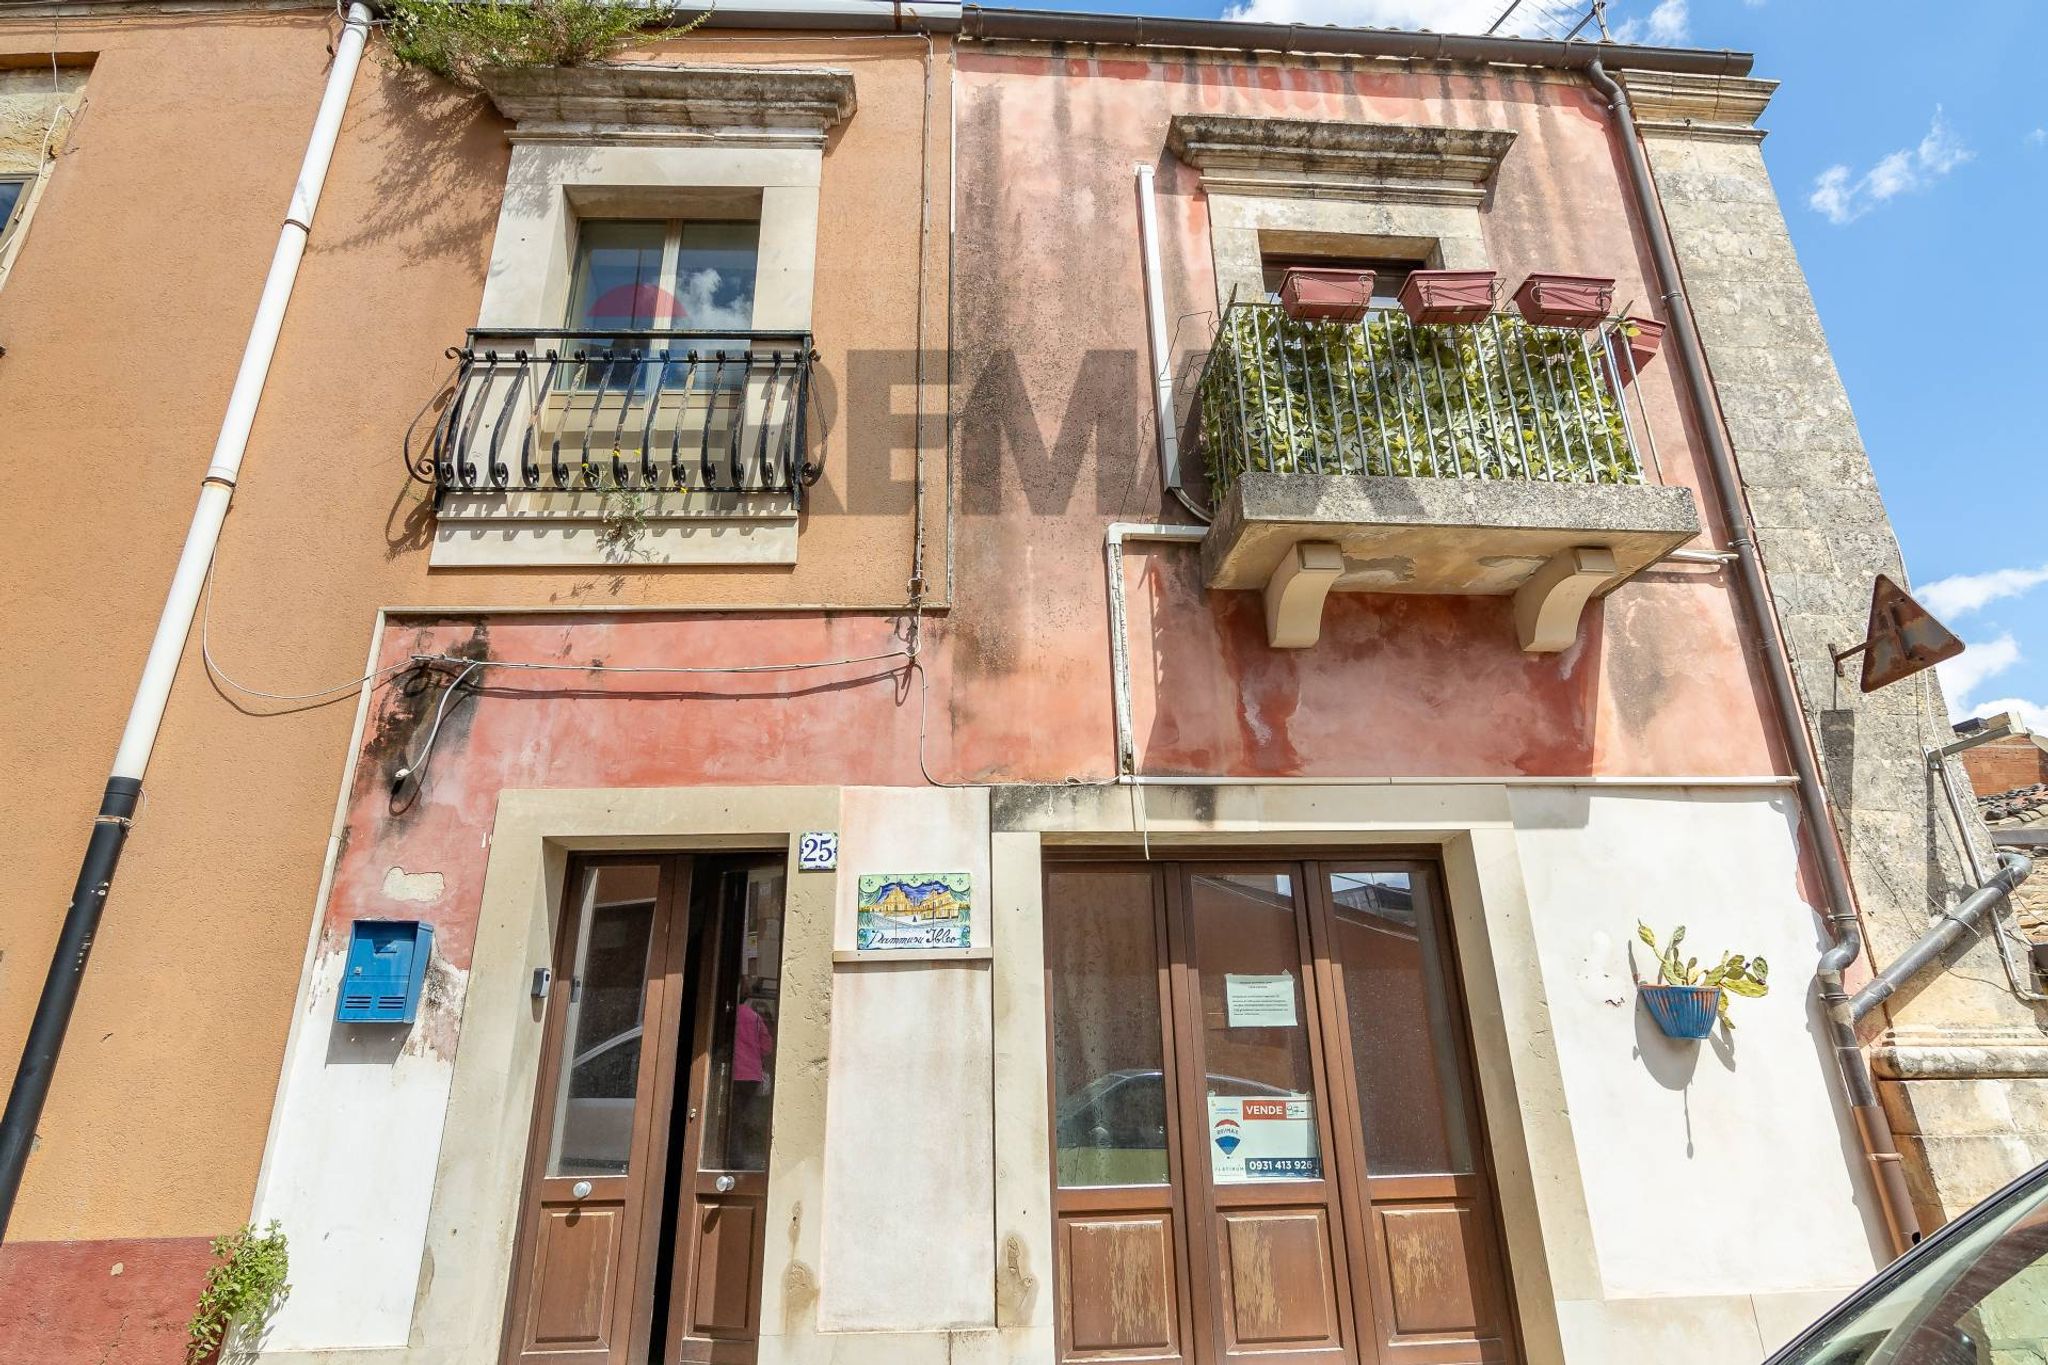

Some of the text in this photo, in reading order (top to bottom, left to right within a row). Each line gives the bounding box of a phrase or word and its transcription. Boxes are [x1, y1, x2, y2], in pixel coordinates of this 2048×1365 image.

[803, 838, 832, 862] 25
[1245, 1105, 1283, 1115] VENDE
[1249, 1160, 1313, 1170] 0931 413 926
